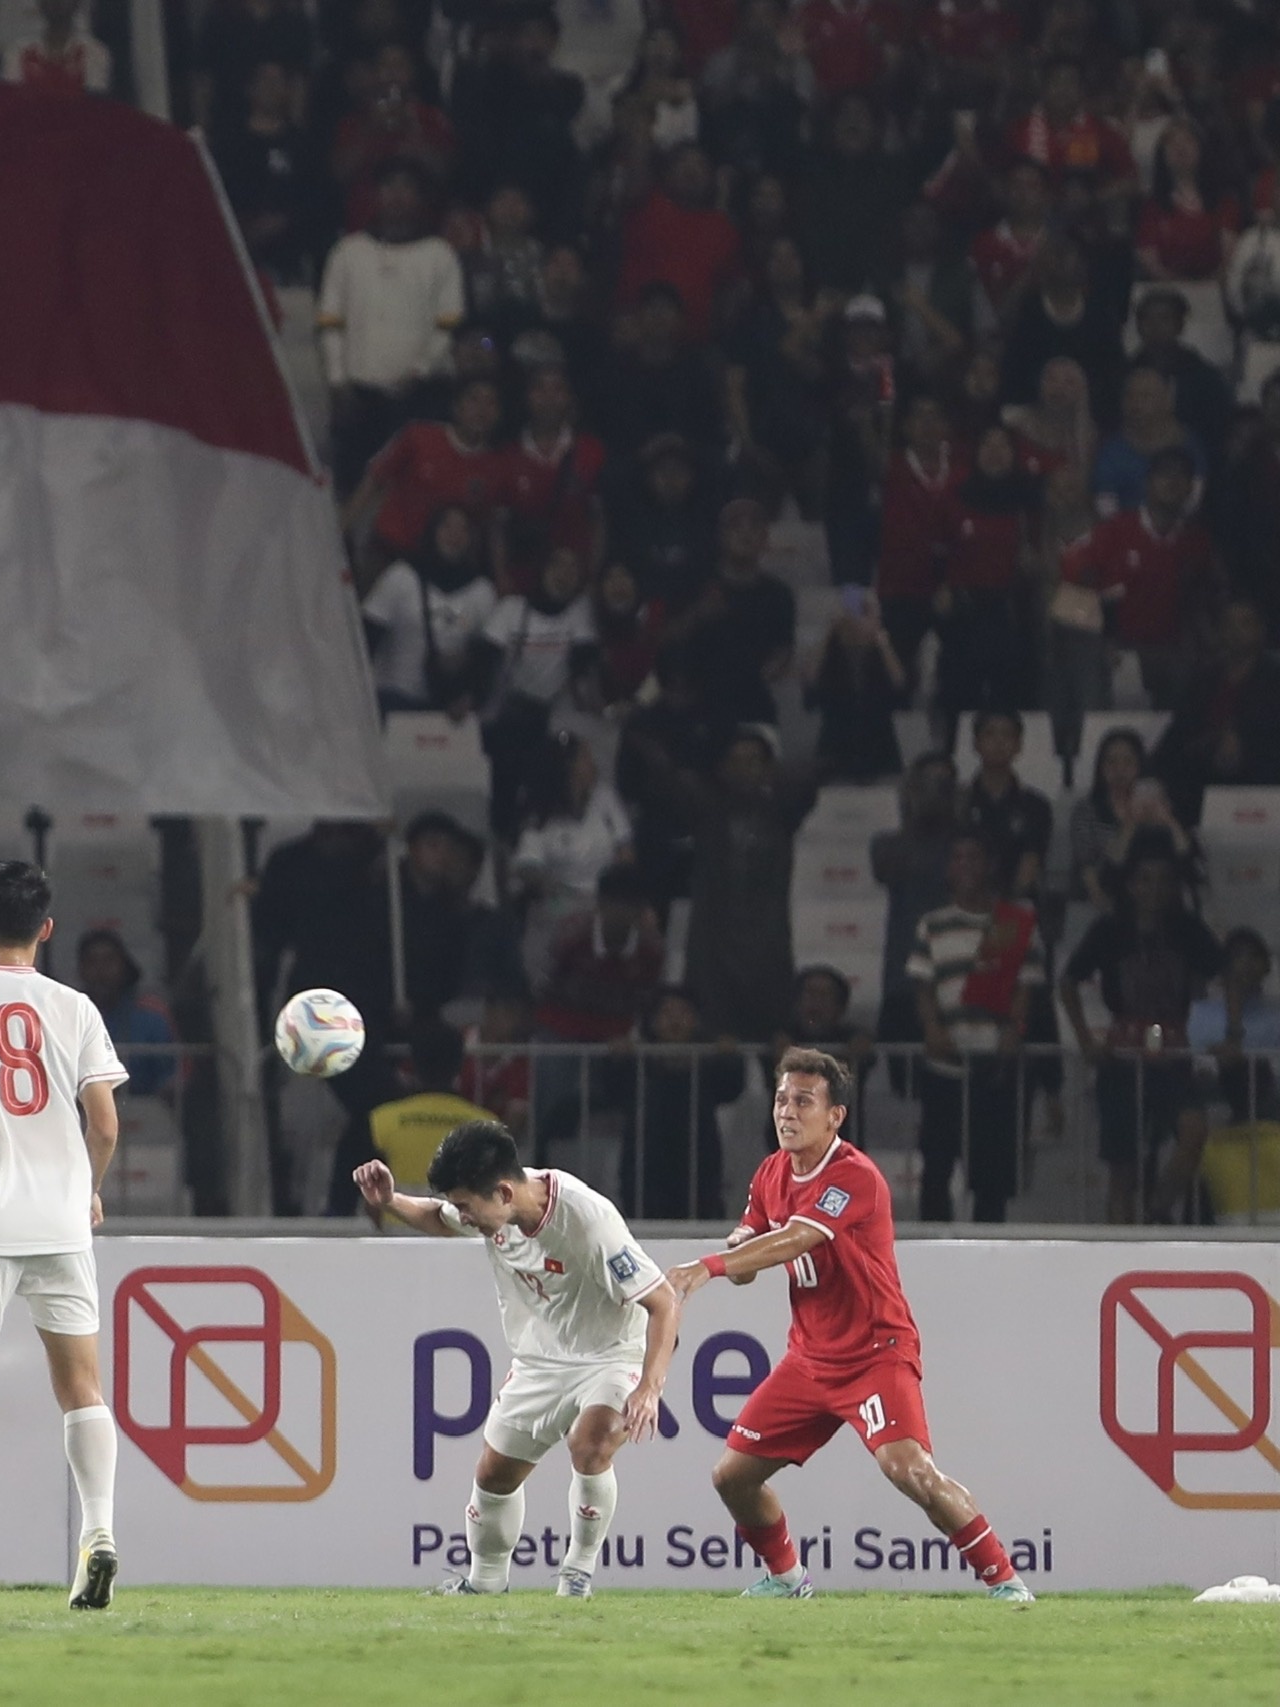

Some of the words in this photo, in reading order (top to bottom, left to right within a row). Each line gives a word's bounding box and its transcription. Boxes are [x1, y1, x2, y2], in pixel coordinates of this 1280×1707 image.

[792, 1251, 818, 1288] 10
[859, 1393, 886, 1440] 10
[412, 1523, 645, 1568] Paetu
[665, 1525, 832, 1570] Sehri
[854, 1527, 1053, 1581] Samai
